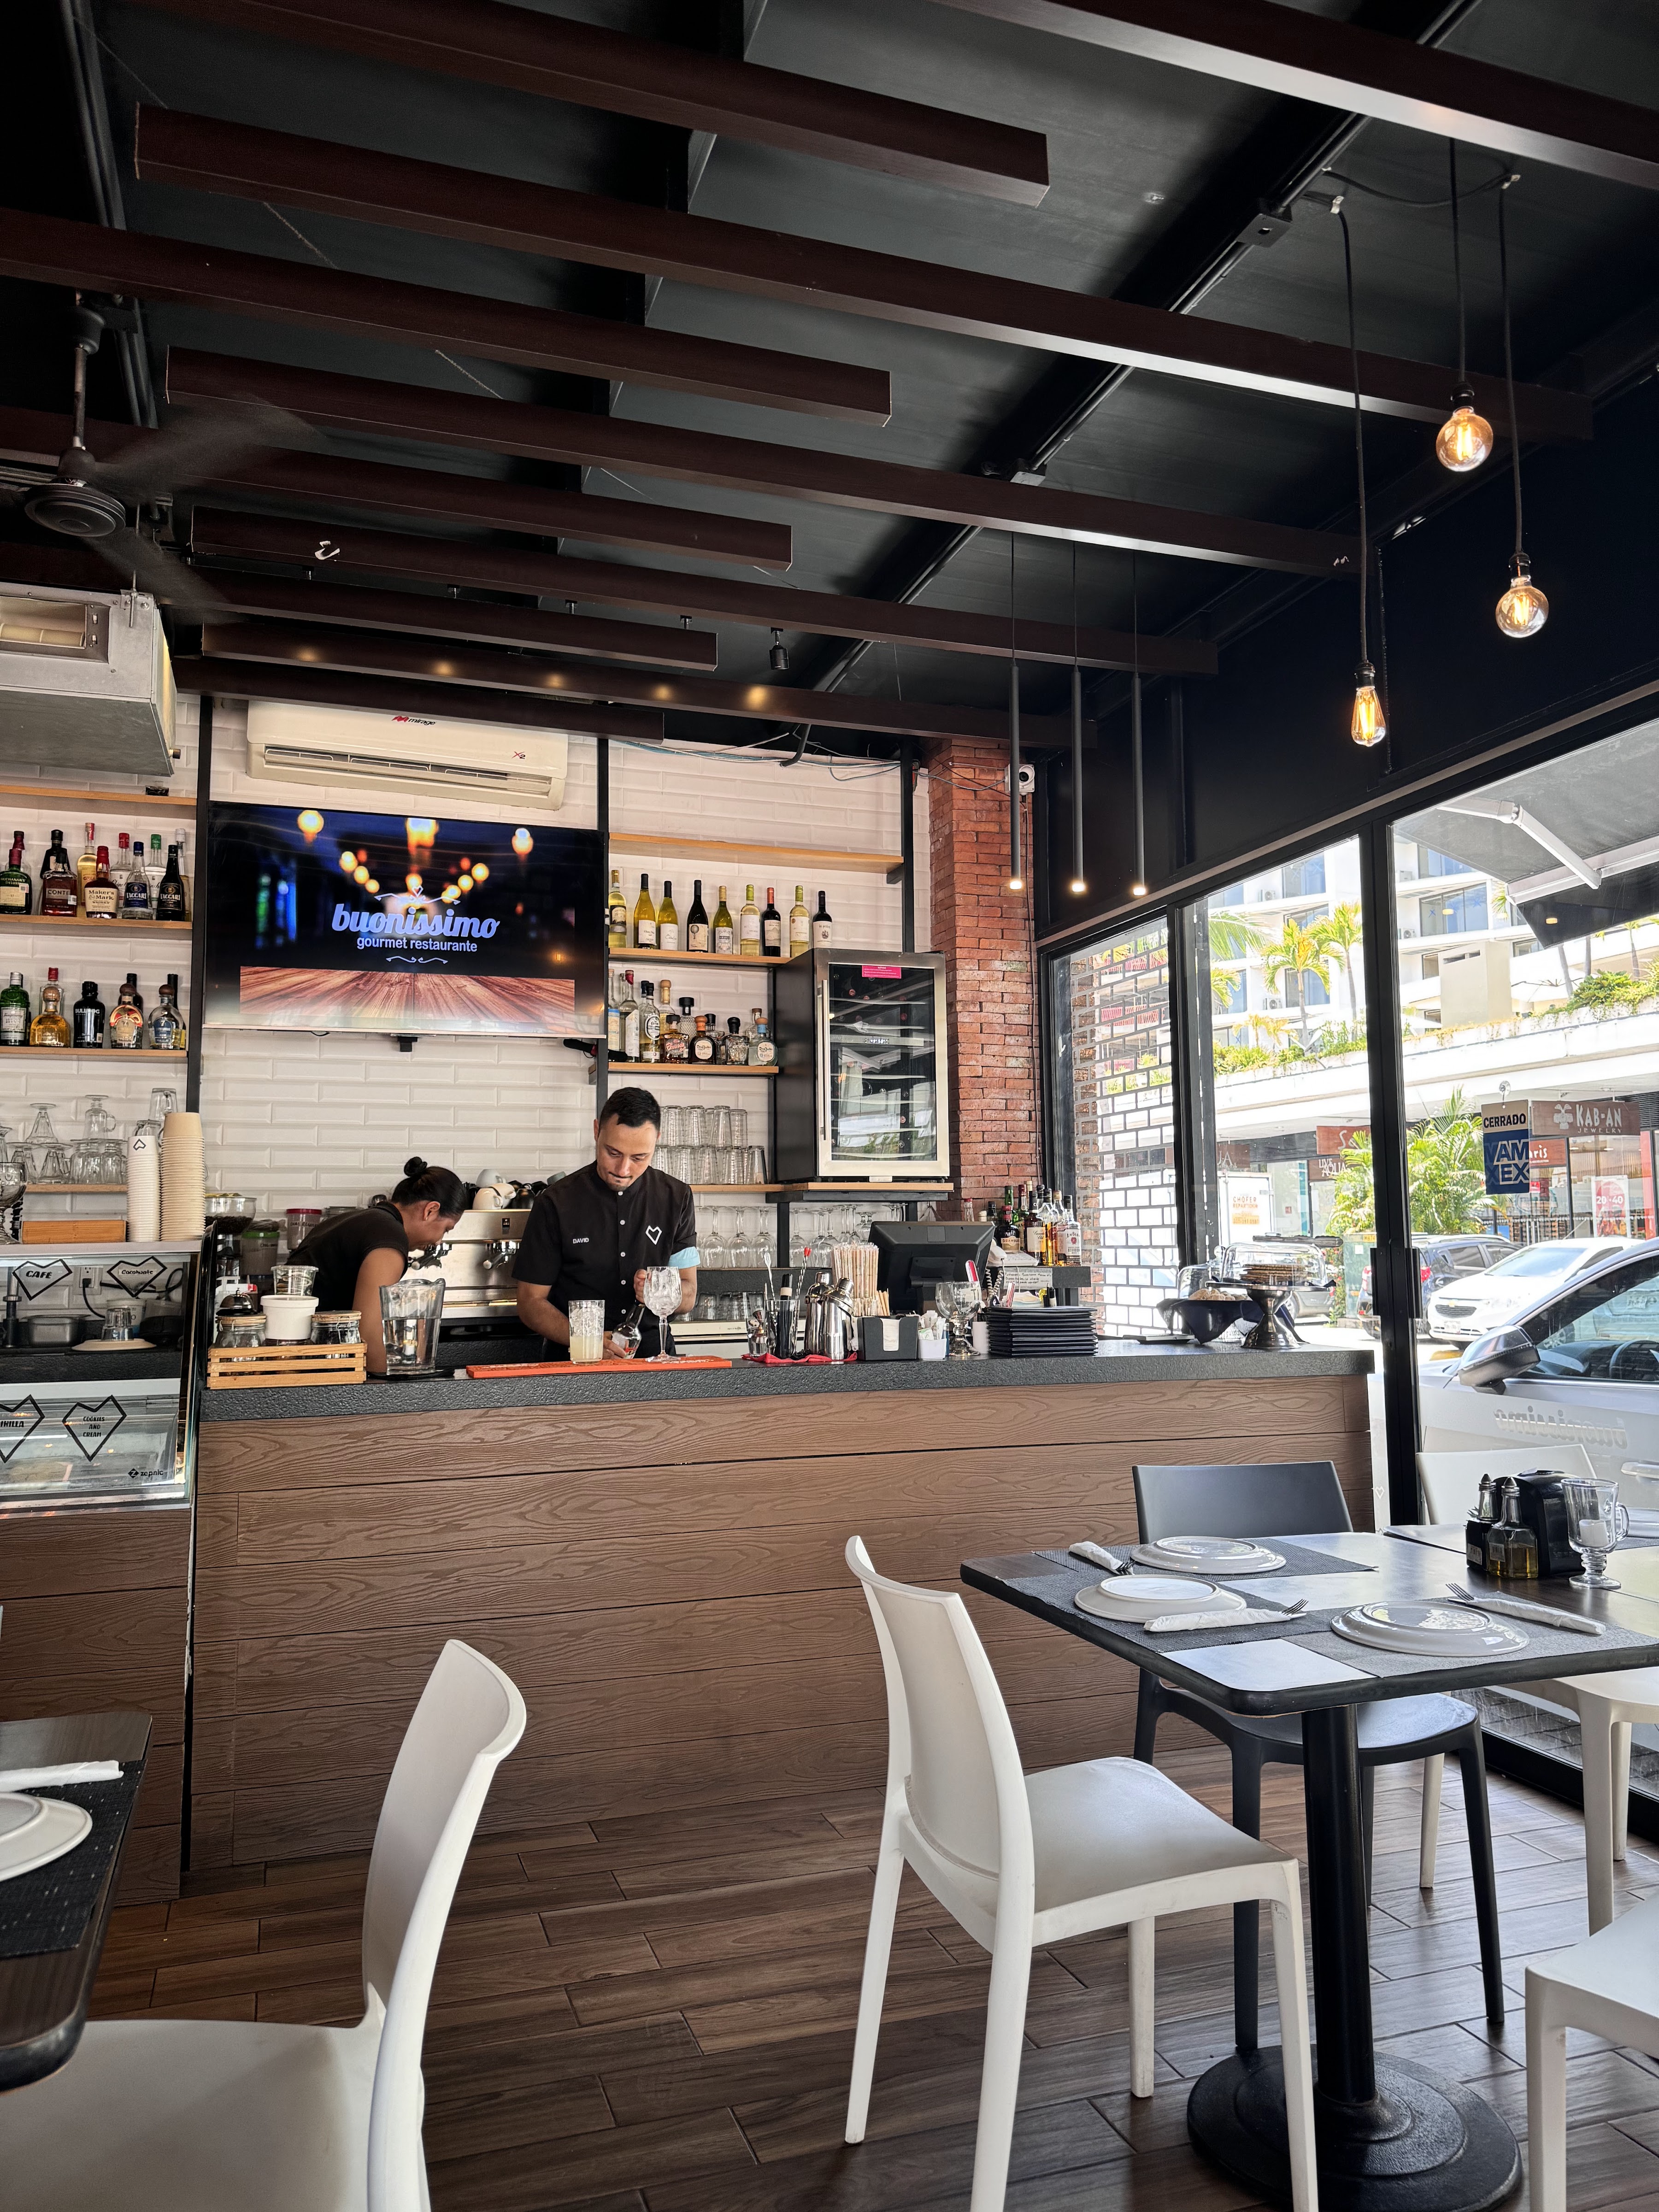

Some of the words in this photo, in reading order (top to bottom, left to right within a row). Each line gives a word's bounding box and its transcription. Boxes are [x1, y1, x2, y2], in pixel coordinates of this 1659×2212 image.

[332, 903, 500, 938] buonissimo
[357, 937, 407, 949] gourmet
[410, 938, 477, 952] restaurante
[1483, 1113, 1526, 1128] CERRADO
[1576, 1104, 1622, 1127] KAB-AN
[1494, 1139, 1529, 1164] AM
[1318, 1158, 1333, 1168] LIVE
[1322, 1162, 1347, 1177] AQUA
[1500, 1163, 1529, 1184] EX
